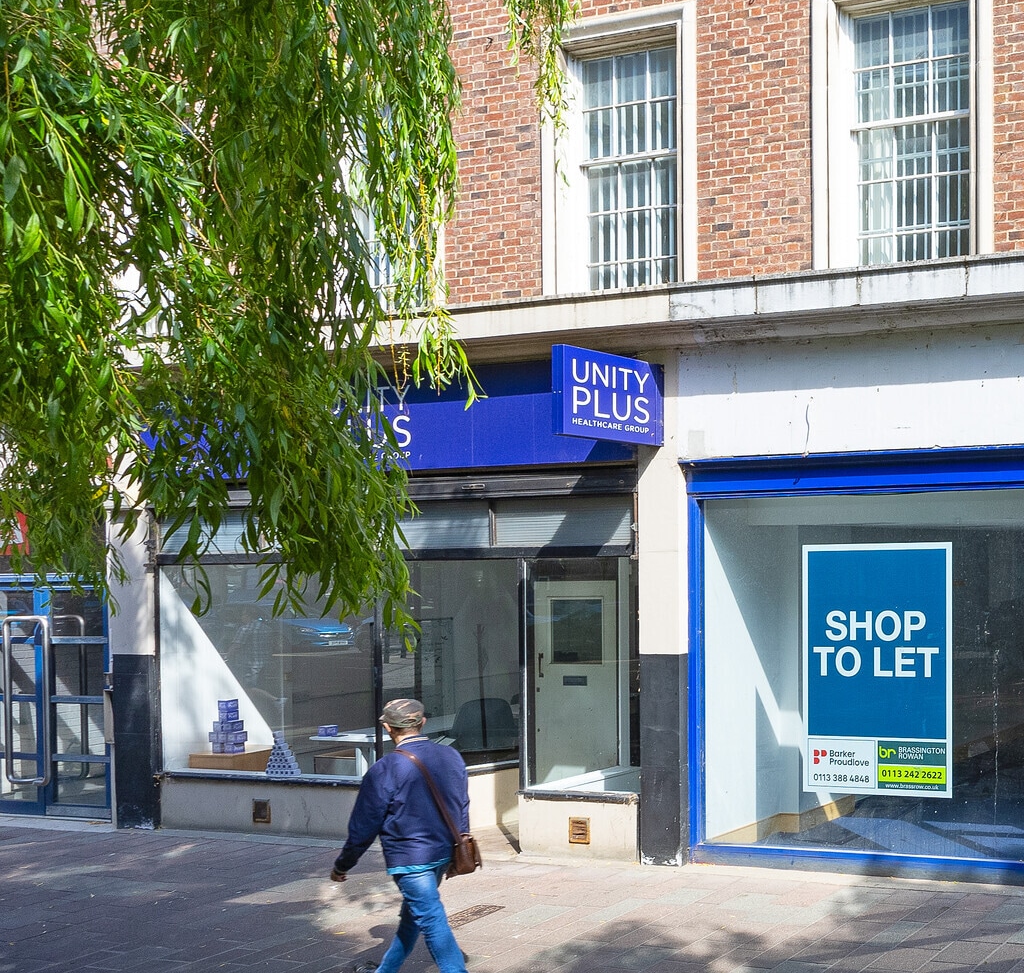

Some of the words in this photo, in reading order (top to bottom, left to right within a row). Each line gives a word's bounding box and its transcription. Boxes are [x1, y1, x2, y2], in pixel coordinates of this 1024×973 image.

[572, 358, 650, 394] UNITY
[572, 386, 650, 424] PLUS
[572, 417, 623, 431] HEALTHCARE
[624, 424, 650, 434] GROUP
[825, 610, 927, 641] SHOP
[813, 646, 862, 677] TO
[873, 647, 940, 678] LET
[829, 750, 856, 758] Barker
[898, 746, 946, 755] BRASSINGTON
[829, 758, 870, 767] Proudlove
[813, 773, 831, 782] 0113
[832, 774, 848, 783] 388
[849, 774, 870, 783] 4848
[881, 769, 902, 778] 0113
[904, 770, 920, 779] 242
[921, 771, 943, 780] 2622
